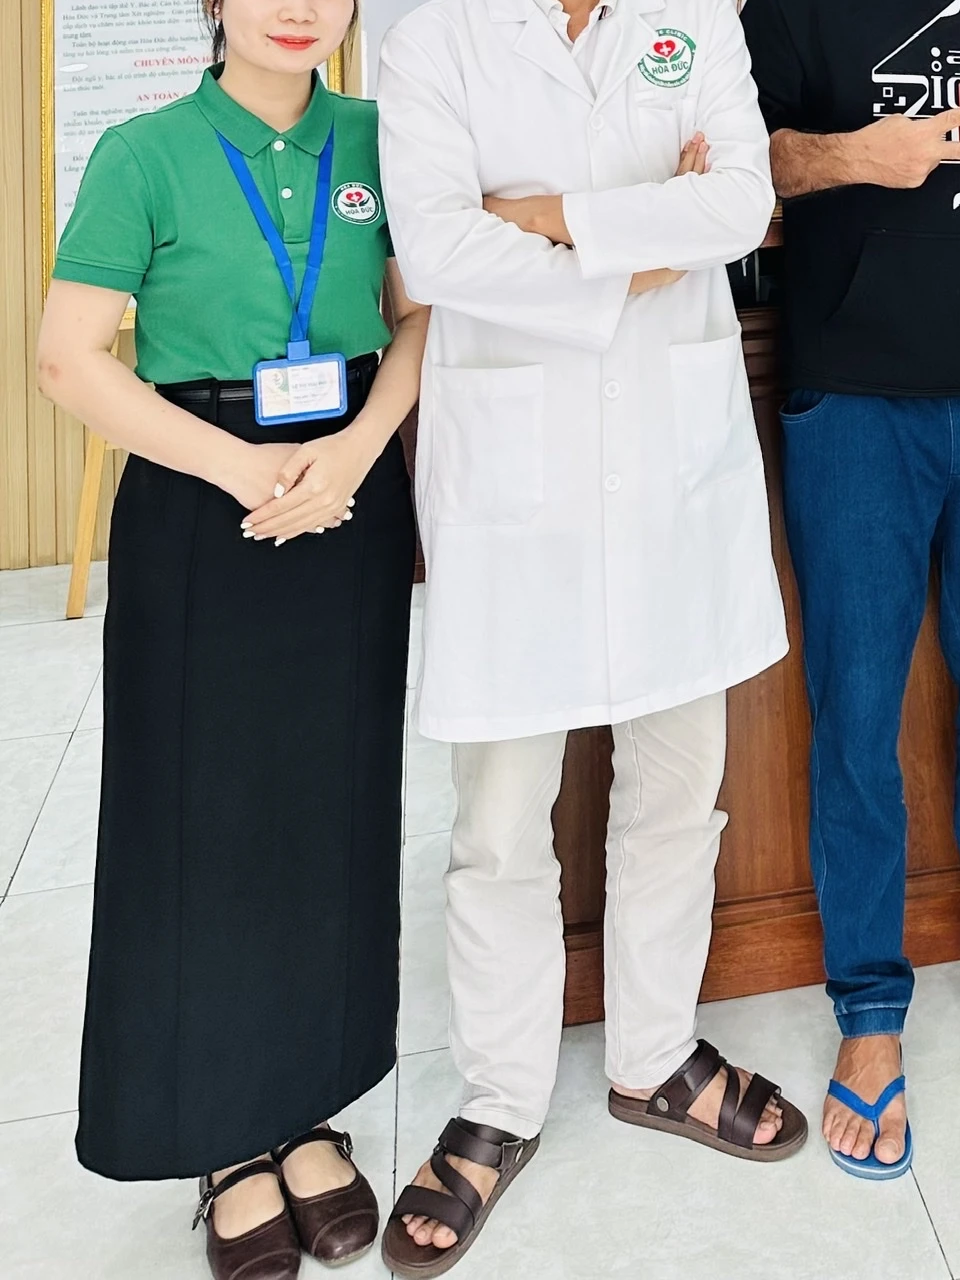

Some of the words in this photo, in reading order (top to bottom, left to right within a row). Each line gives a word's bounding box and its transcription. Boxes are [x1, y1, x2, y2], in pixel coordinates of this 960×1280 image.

[134, 57, 174, 67] CHUYÊN
[178, 56, 199, 65] MÔN
[652, 64, 669, 75] HÒA
[671, 61, 689, 71] ĐỨC
[153, 92, 179, 101] TOÀN
